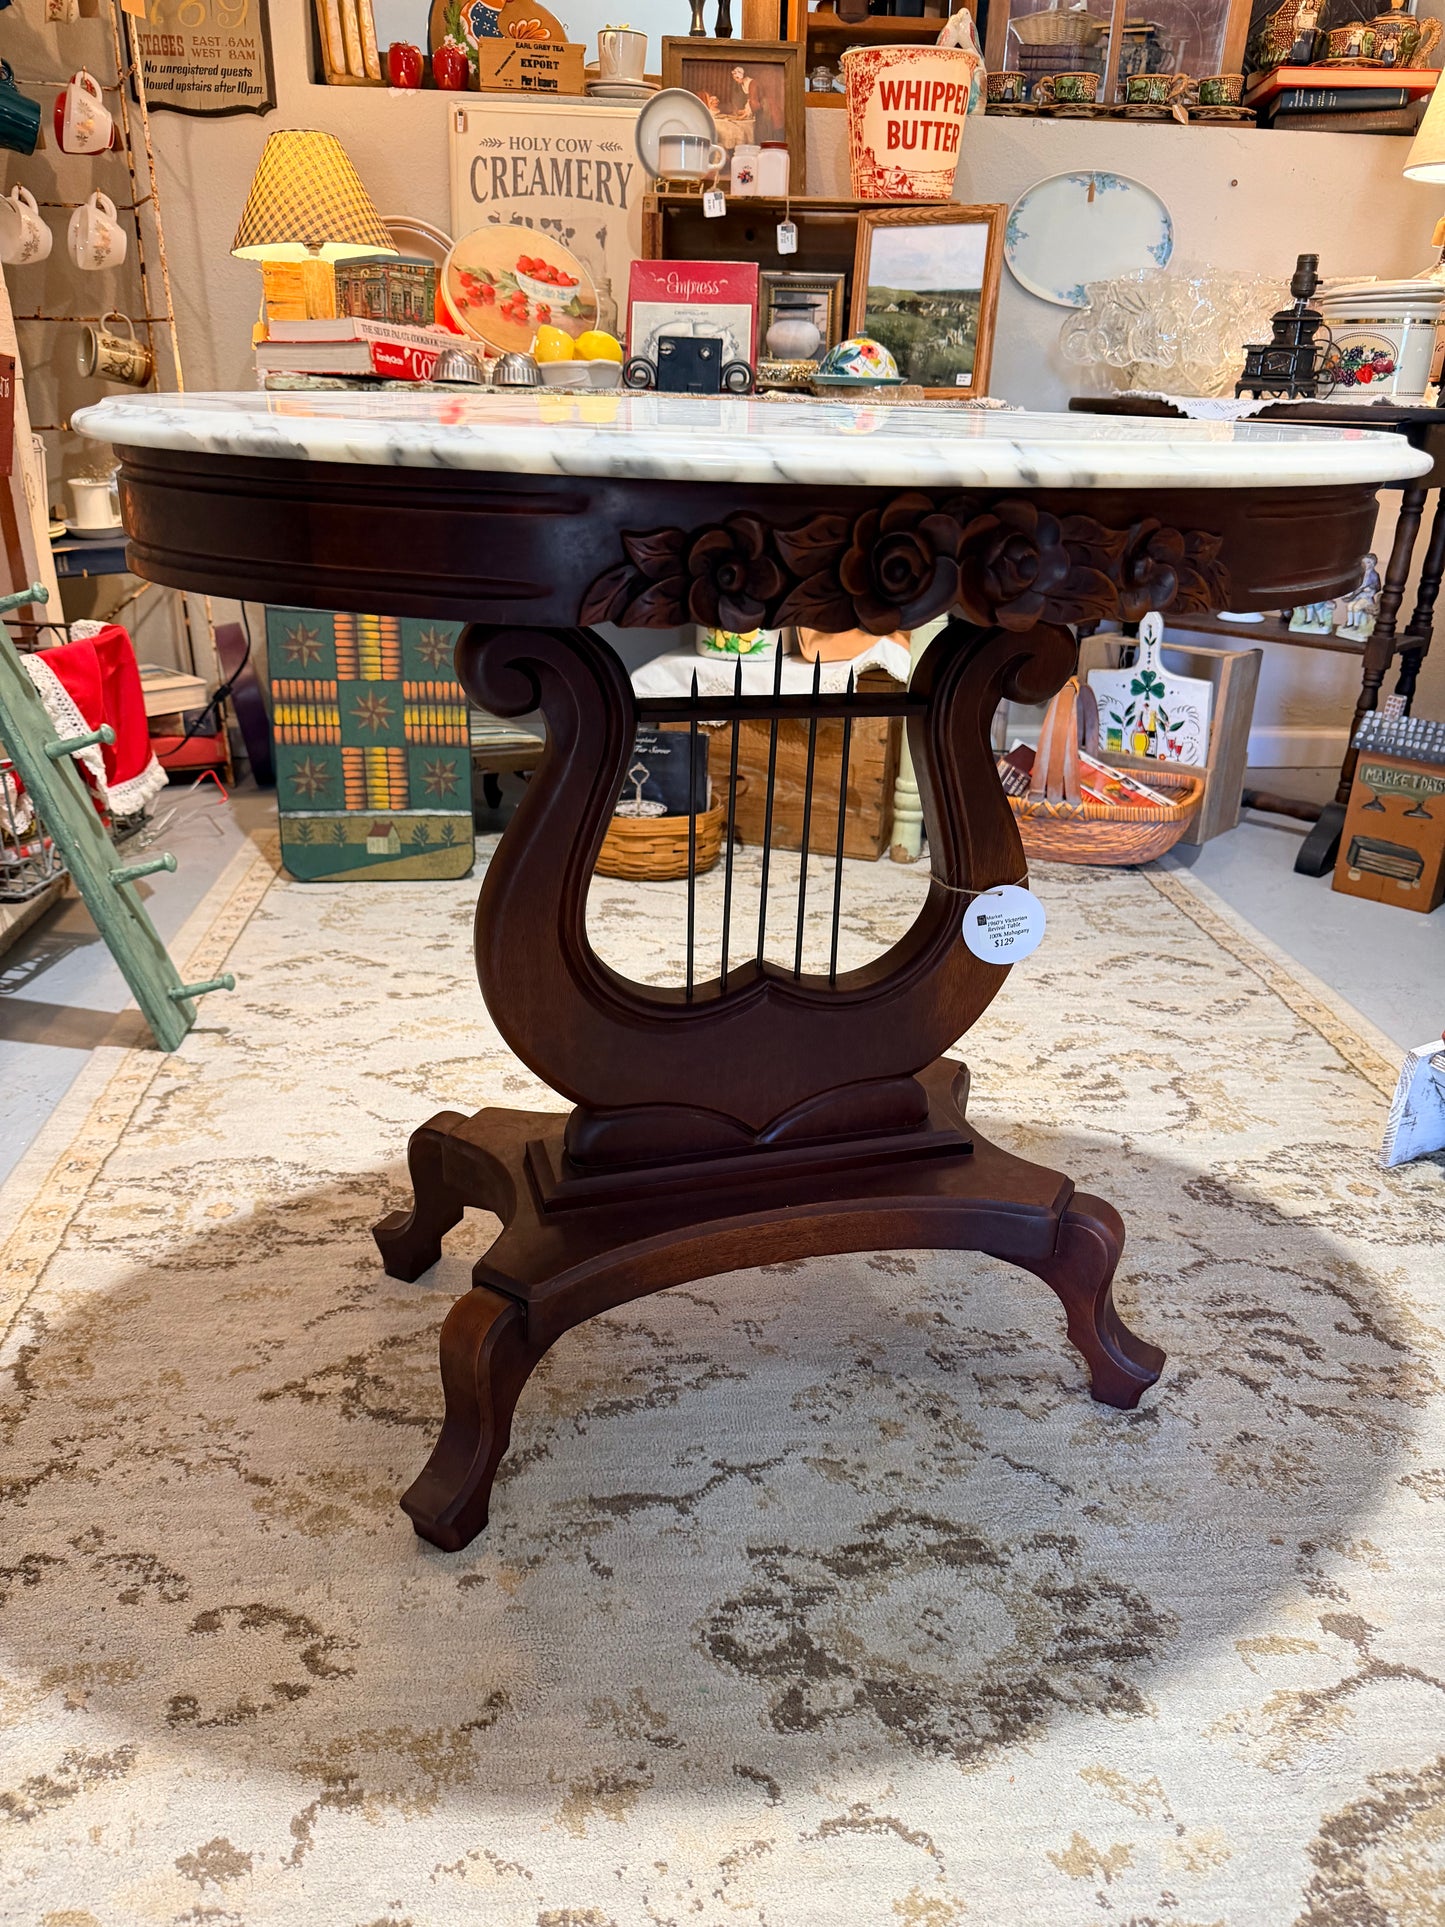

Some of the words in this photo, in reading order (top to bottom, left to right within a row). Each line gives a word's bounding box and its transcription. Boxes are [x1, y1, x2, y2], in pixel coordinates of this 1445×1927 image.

[137, 34, 185, 57] STAGES
[192, 36, 221, 46] EAST
[515, 41, 532, 50] EARL
[533, 43, 551, 52] GREY
[552, 45, 565, 53] TEA
[191, 48, 222, 58] WEST
[228, 50, 256, 60] 8AM
[144, 60, 157, 73] No
[159, 63, 219, 76] unregistered
[220, 66, 253, 78] guests
[520, 58, 560, 70] EXPORT
[143, 77, 174, 91] llowed
[176, 80, 212, 93] upstairs
[214, 81, 236, 93] after
[879, 80, 969, 116] WHIPPED
[509, 136, 551, 151] HOLY
[555, 138, 593, 153] COW
[887, 120, 960, 153] BUTTER
[470, 155, 634, 210] CREAMERY
[667, 272, 720, 301] Empress
[1365, 768, 1420, 788] MARKET
[1005, 916, 1028, 924] Victorian
[1003, 928, 1030, 937] Mahogany
[994, 937, 1015, 948] $129
